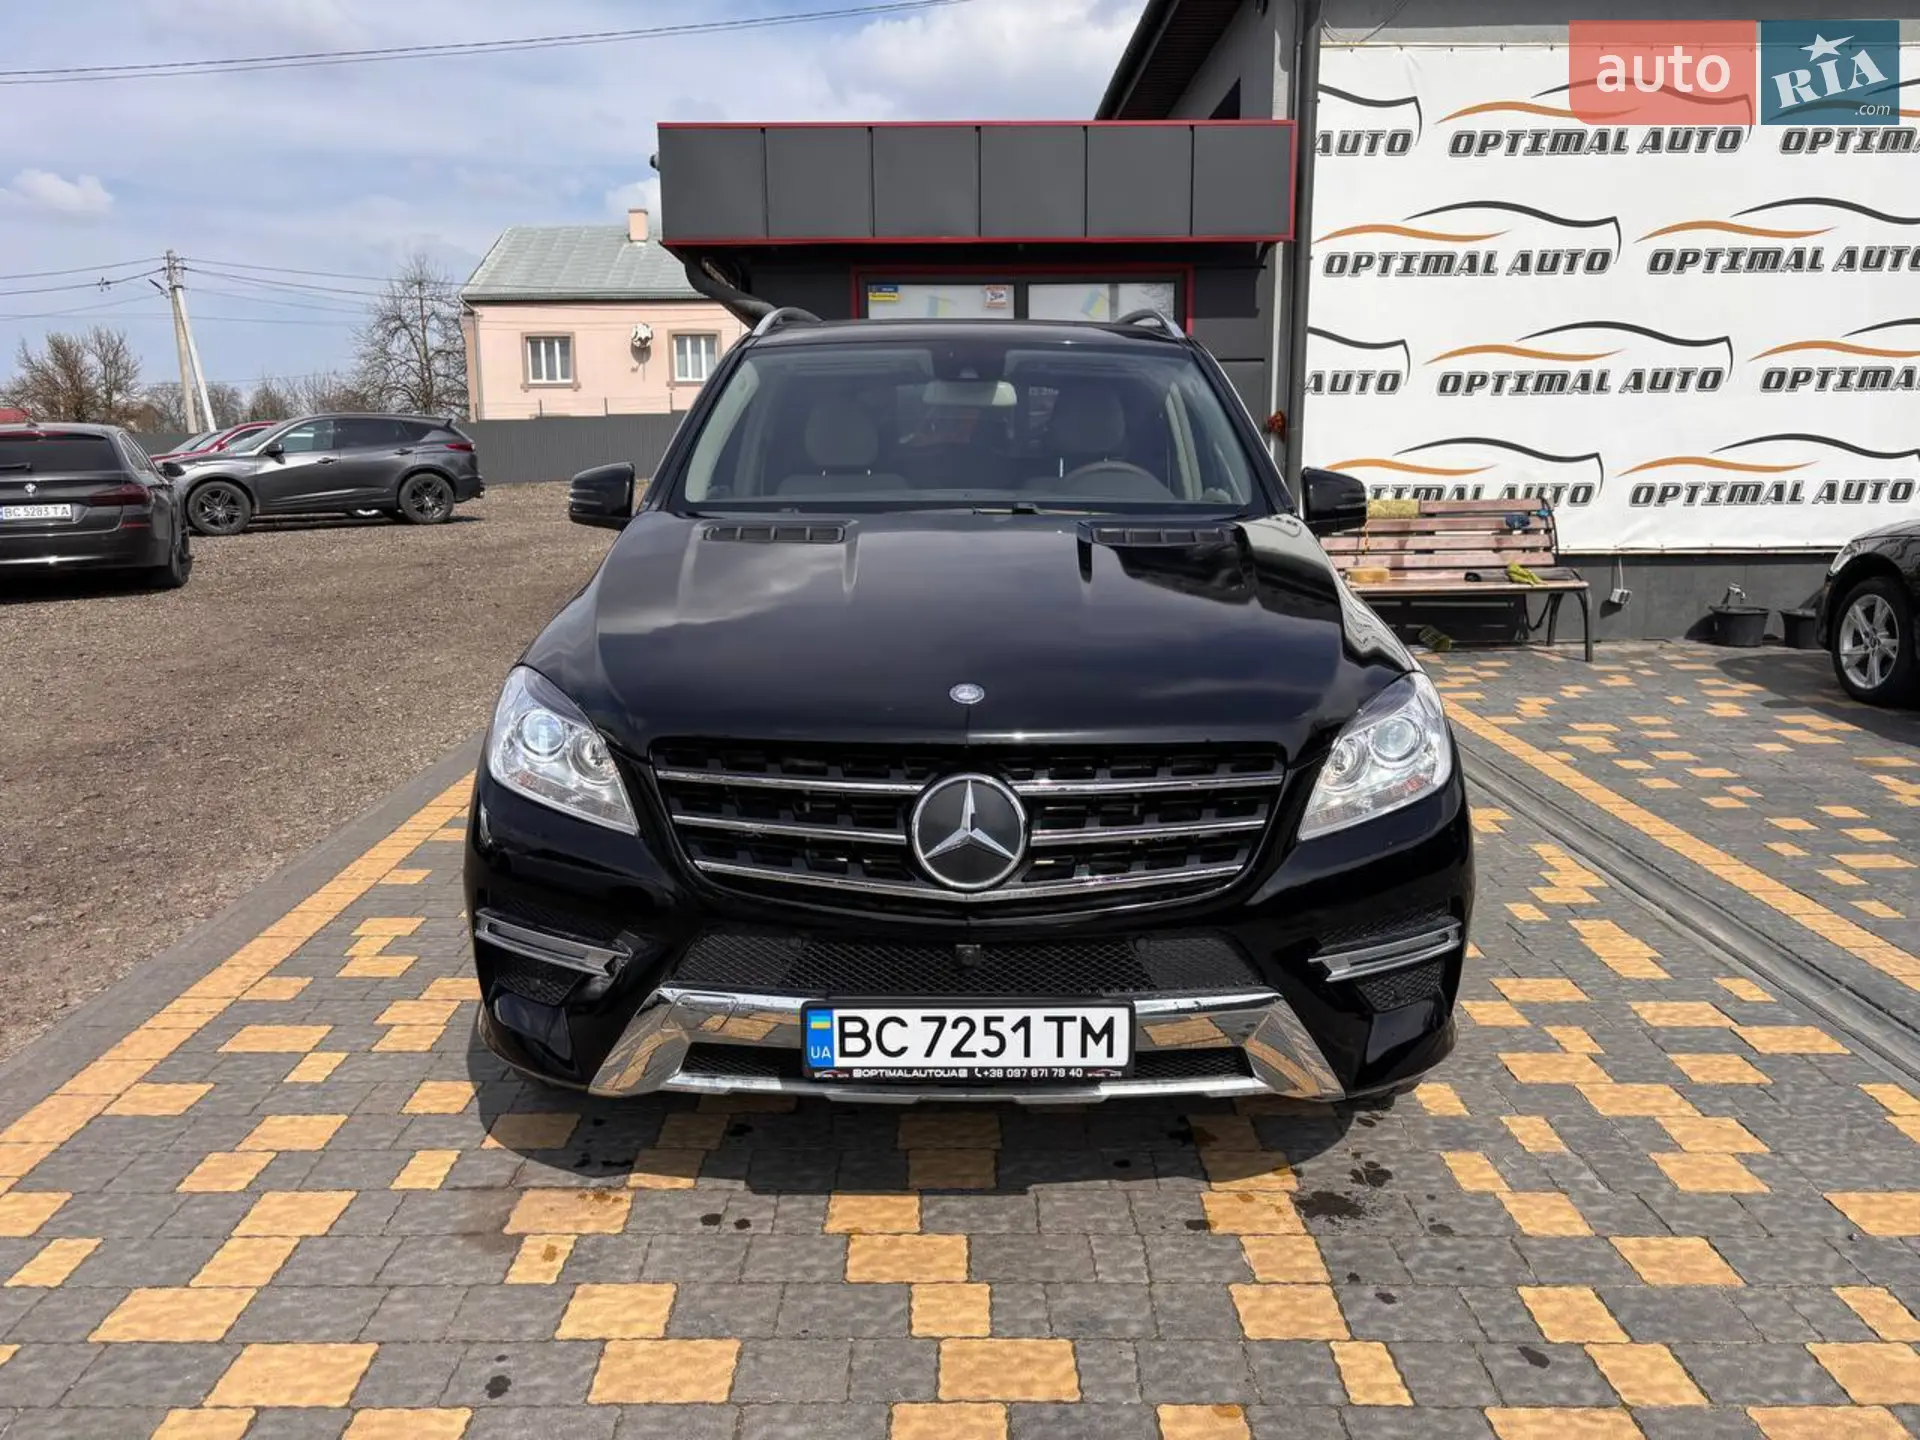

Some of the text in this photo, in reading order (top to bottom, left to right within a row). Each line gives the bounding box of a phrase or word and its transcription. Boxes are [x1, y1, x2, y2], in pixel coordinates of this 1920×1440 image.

[1314, 130, 1413, 156] AUTO
[1448, 126, 1745, 158] OPTIMAL AUTO
[1779, 126, 1920, 156] OPTIM
[1322, 248, 1614, 277] OPTIMAL AUTO
[1646, 246, 1824, 275] OPTIMAL
[1303, 370, 1402, 395] AUTO
[1437, 367, 1724, 396] OPTIMAL AUTO
[1760, 365, 1920, 392] OPTIMA
[1499, 482, 1596, 507] AUTO
[1629, 478, 1916, 507] OPTIMAL AUTO
[4, 507, 21, 518] BC
[52, 505, 69, 516] TA
[838, 1015, 1115, 1059] BC 7251 TM
[811, 1046, 832, 1060] UA
[983, 1068, 1003, 1078] +38
[1006, 1068, 1027, 1078] 097
[1069, 1068, 1083, 1078] 40
